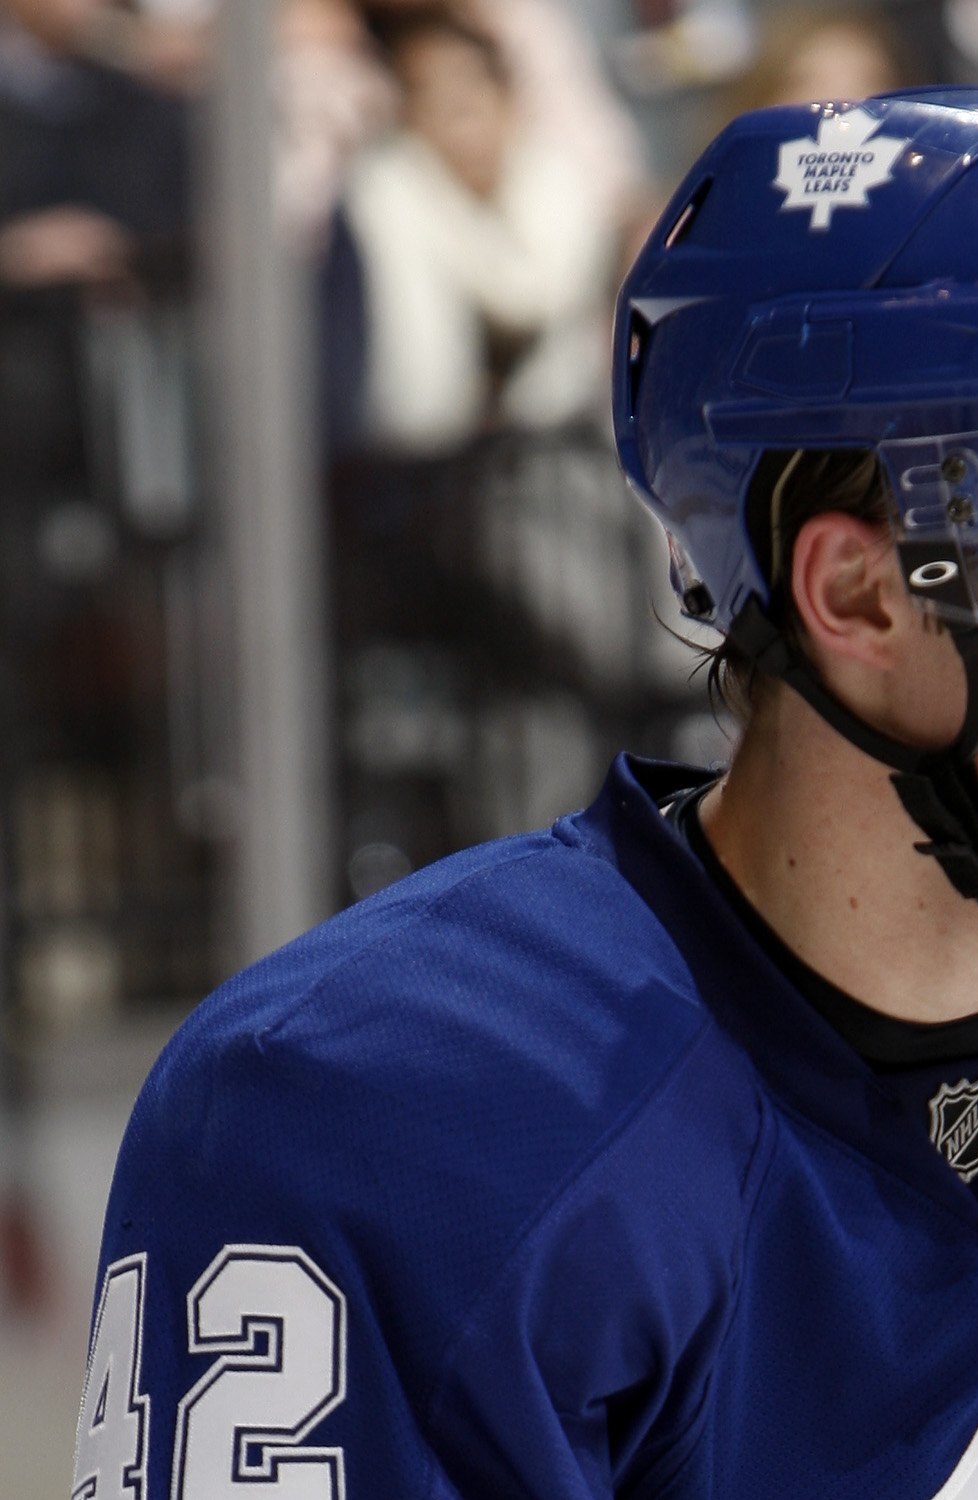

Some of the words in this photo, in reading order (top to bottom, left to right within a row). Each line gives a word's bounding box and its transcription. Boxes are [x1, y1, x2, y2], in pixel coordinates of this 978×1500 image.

[797, 151, 875, 166] TORONTO
[803, 164, 858, 178] MAPLE
[804, 179, 851, 193] LEAFS
